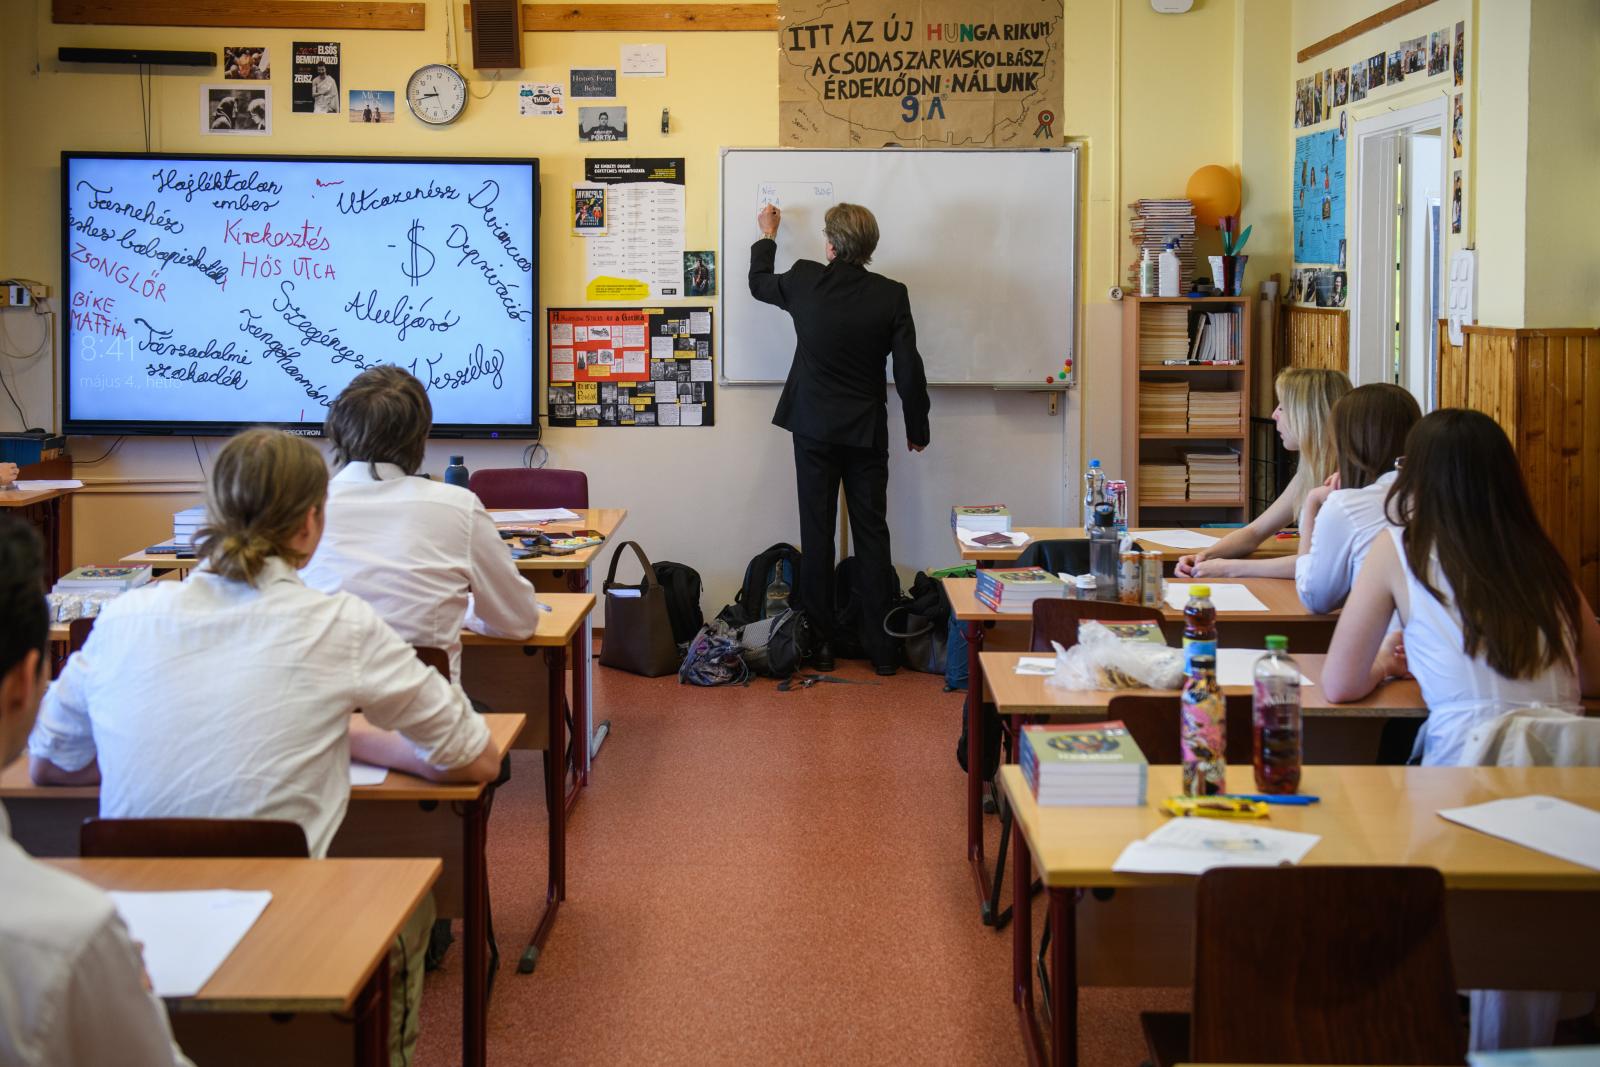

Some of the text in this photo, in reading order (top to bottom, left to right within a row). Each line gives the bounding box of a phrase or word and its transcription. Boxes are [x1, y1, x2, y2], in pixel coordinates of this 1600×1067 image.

[788, 24, 833, 51] ITT
[841, 21, 874, 45] AZ
[883, 13, 913, 42] ÚJ
[811, 47, 1044, 76] A CSODASZARVASKOLBÁSZ
[294, 74, 313, 84] ZEUSZ
[951, 71, 1039, 93] NÁLUNK
[294, 257, 336, 280] UTCA
[80, 335, 135, 362] 8:41
